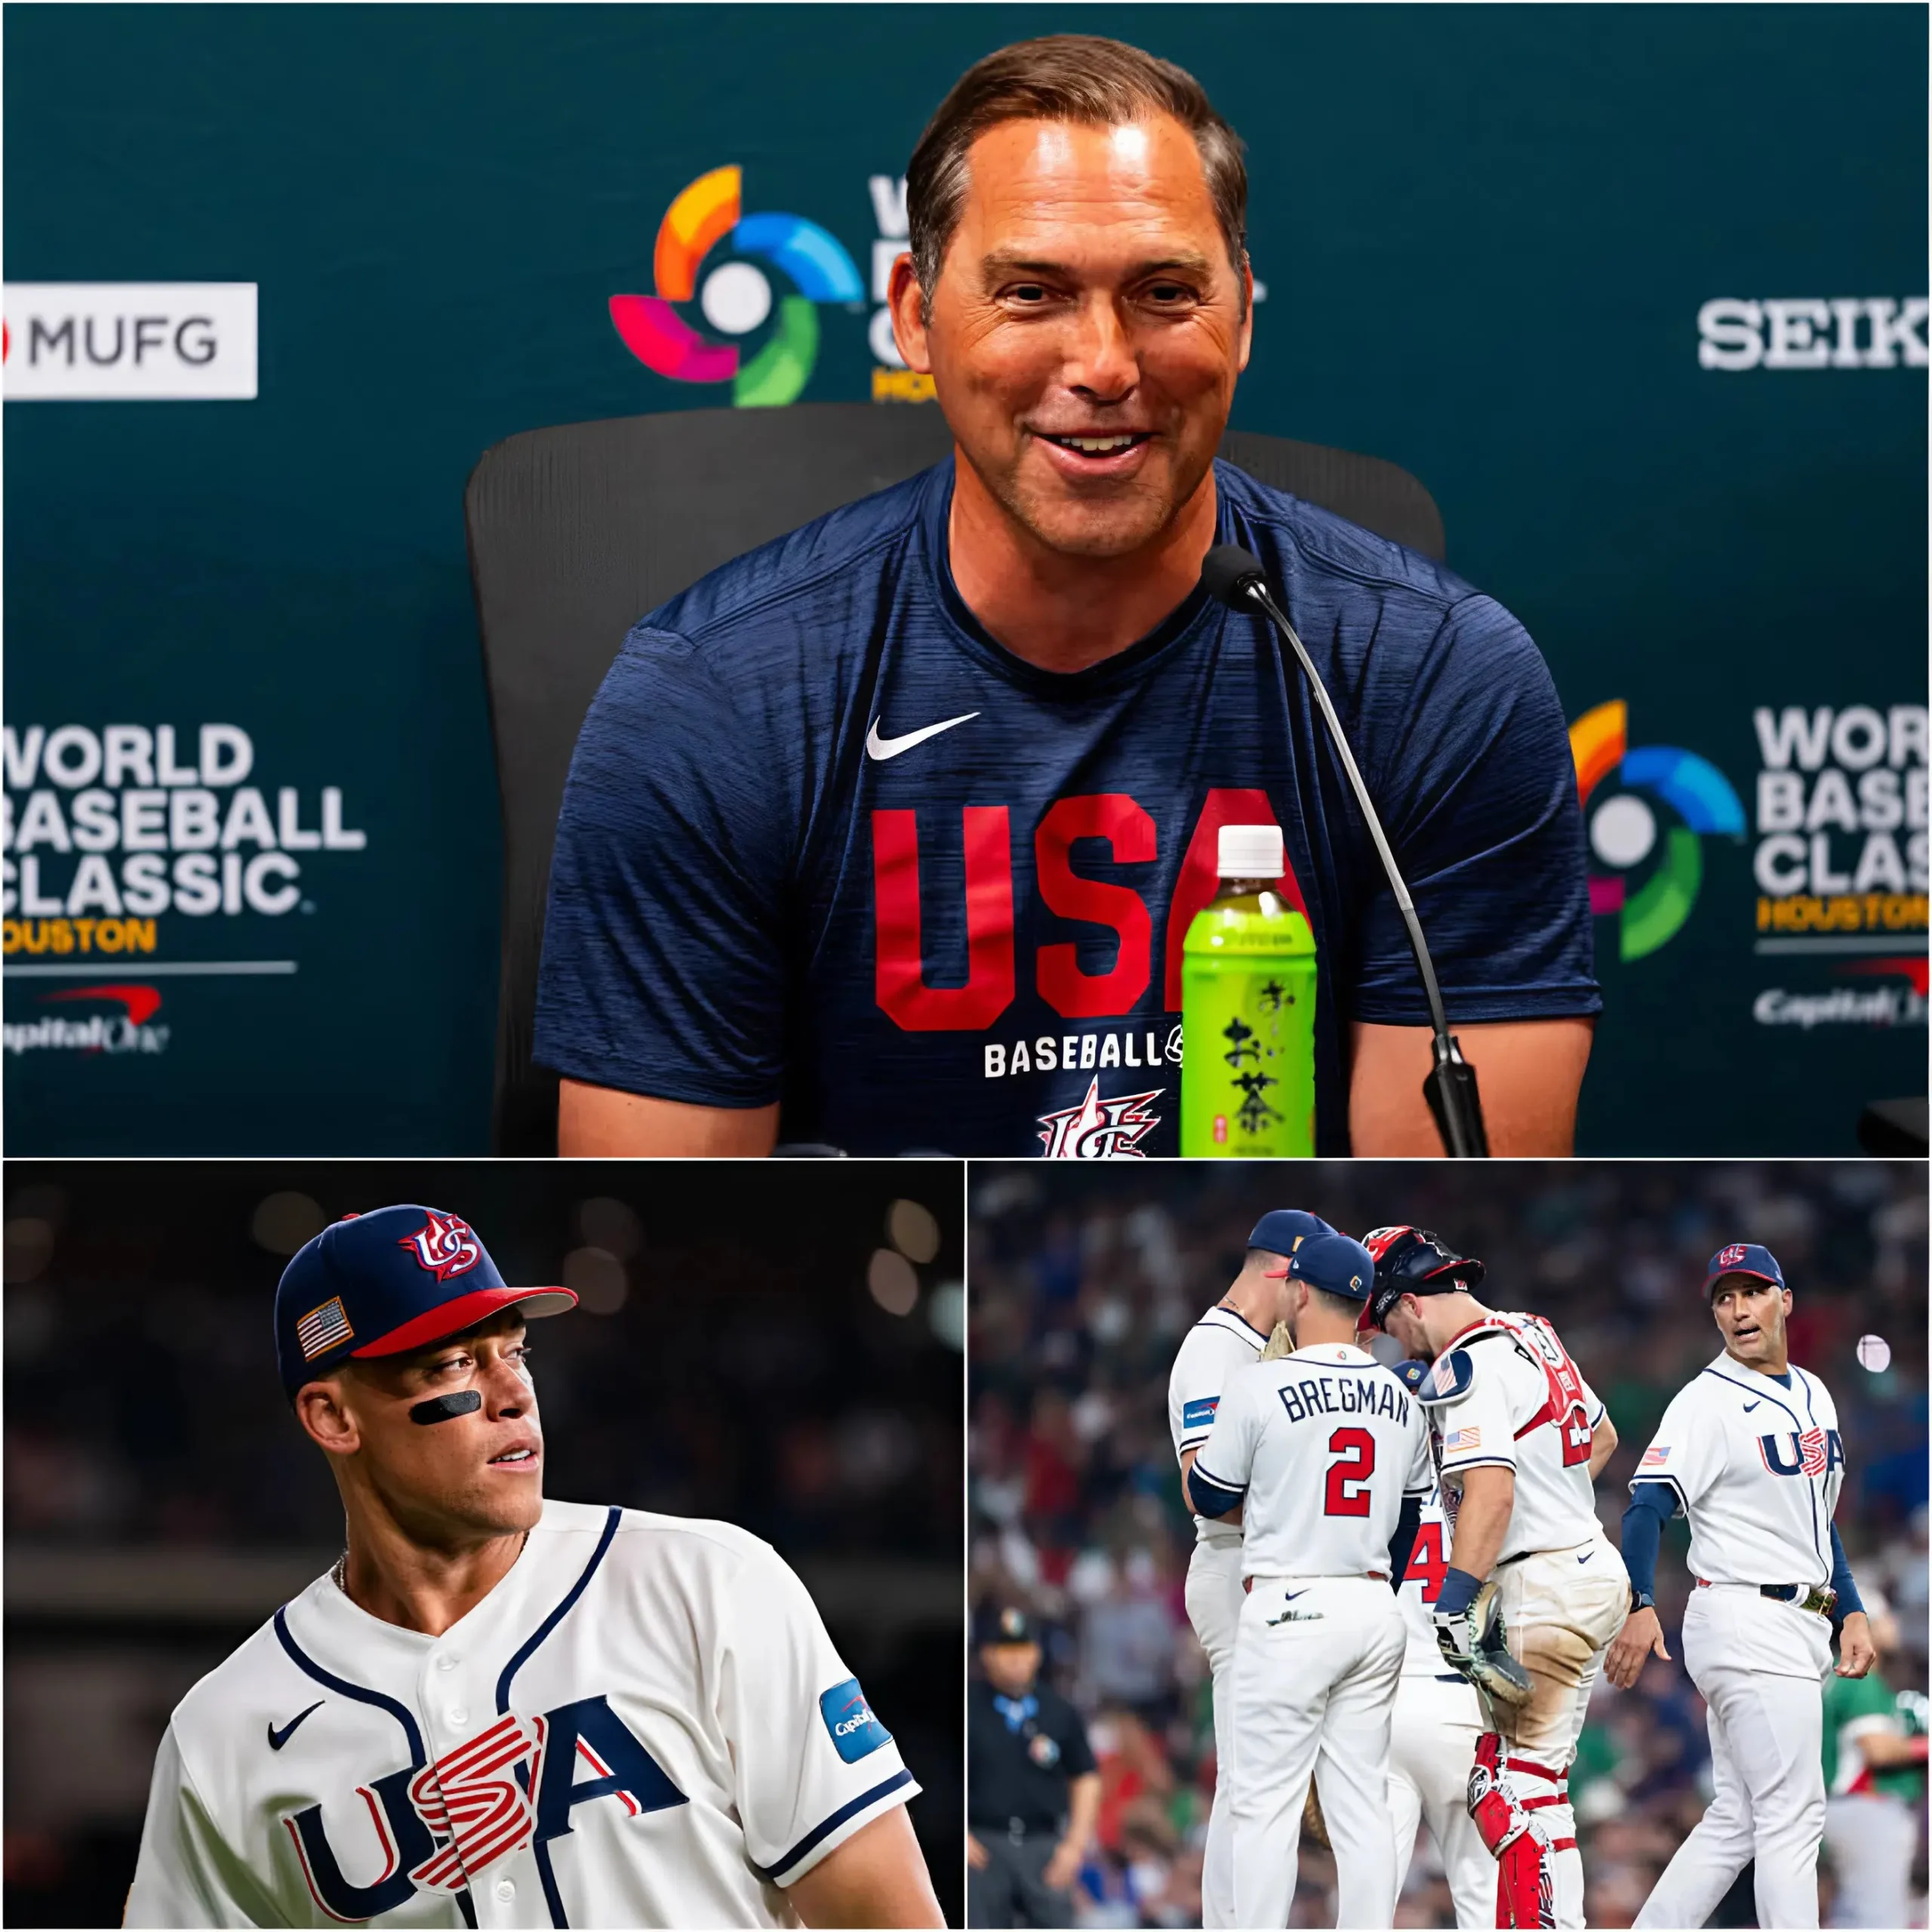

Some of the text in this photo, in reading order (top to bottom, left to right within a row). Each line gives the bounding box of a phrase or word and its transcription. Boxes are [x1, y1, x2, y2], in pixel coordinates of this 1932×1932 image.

[29, 315, 219, 366] MUFG
[1697, 297, 1929, 371] SEIK
[3, 786, 368, 853] ASEBALL
[3, 851, 300, 916] LASSIC
[984, 1032, 1162, 1078] BASEBALL
[1278, 1377, 1410, 1428] BREGMAN
[1324, 1426, 1376, 1518] 2
[1756, 1426, 1845, 1478] USA
[282, 1694, 691, 1923] USA
